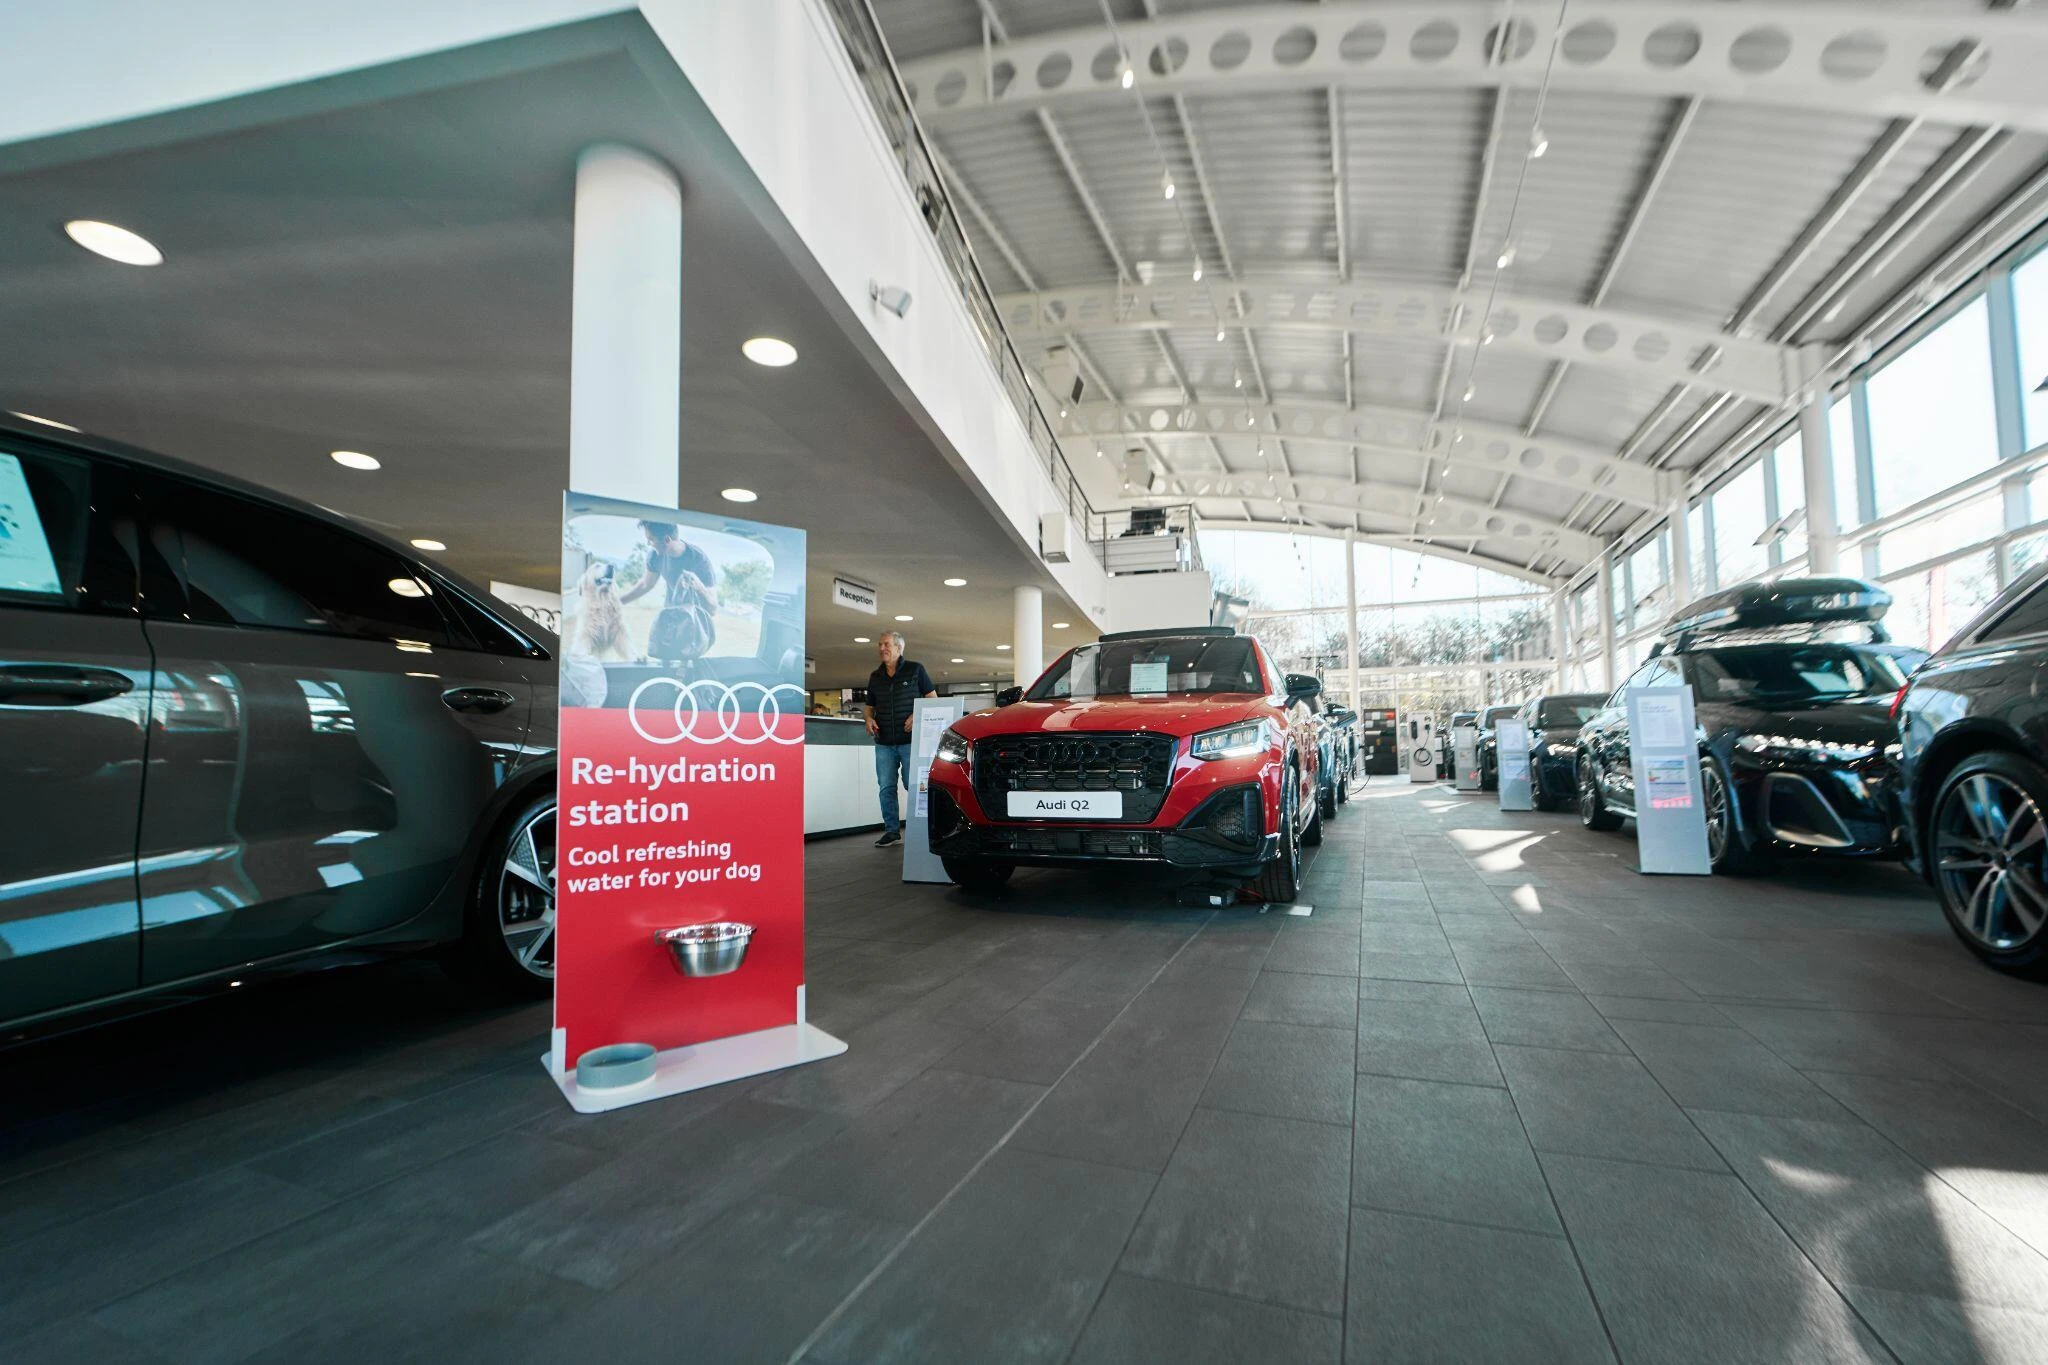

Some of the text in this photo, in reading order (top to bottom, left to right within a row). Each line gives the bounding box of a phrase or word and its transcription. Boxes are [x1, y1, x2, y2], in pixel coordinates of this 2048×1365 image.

[840, 588, 873, 605] Reception
[571, 756, 776, 790] Re-hydration
[569, 797, 689, 827] station
[1035, 799, 1090, 811] Audi Q2
[569, 840, 731, 866] Cool refreshing
[567, 861, 762, 894] water for your dog
